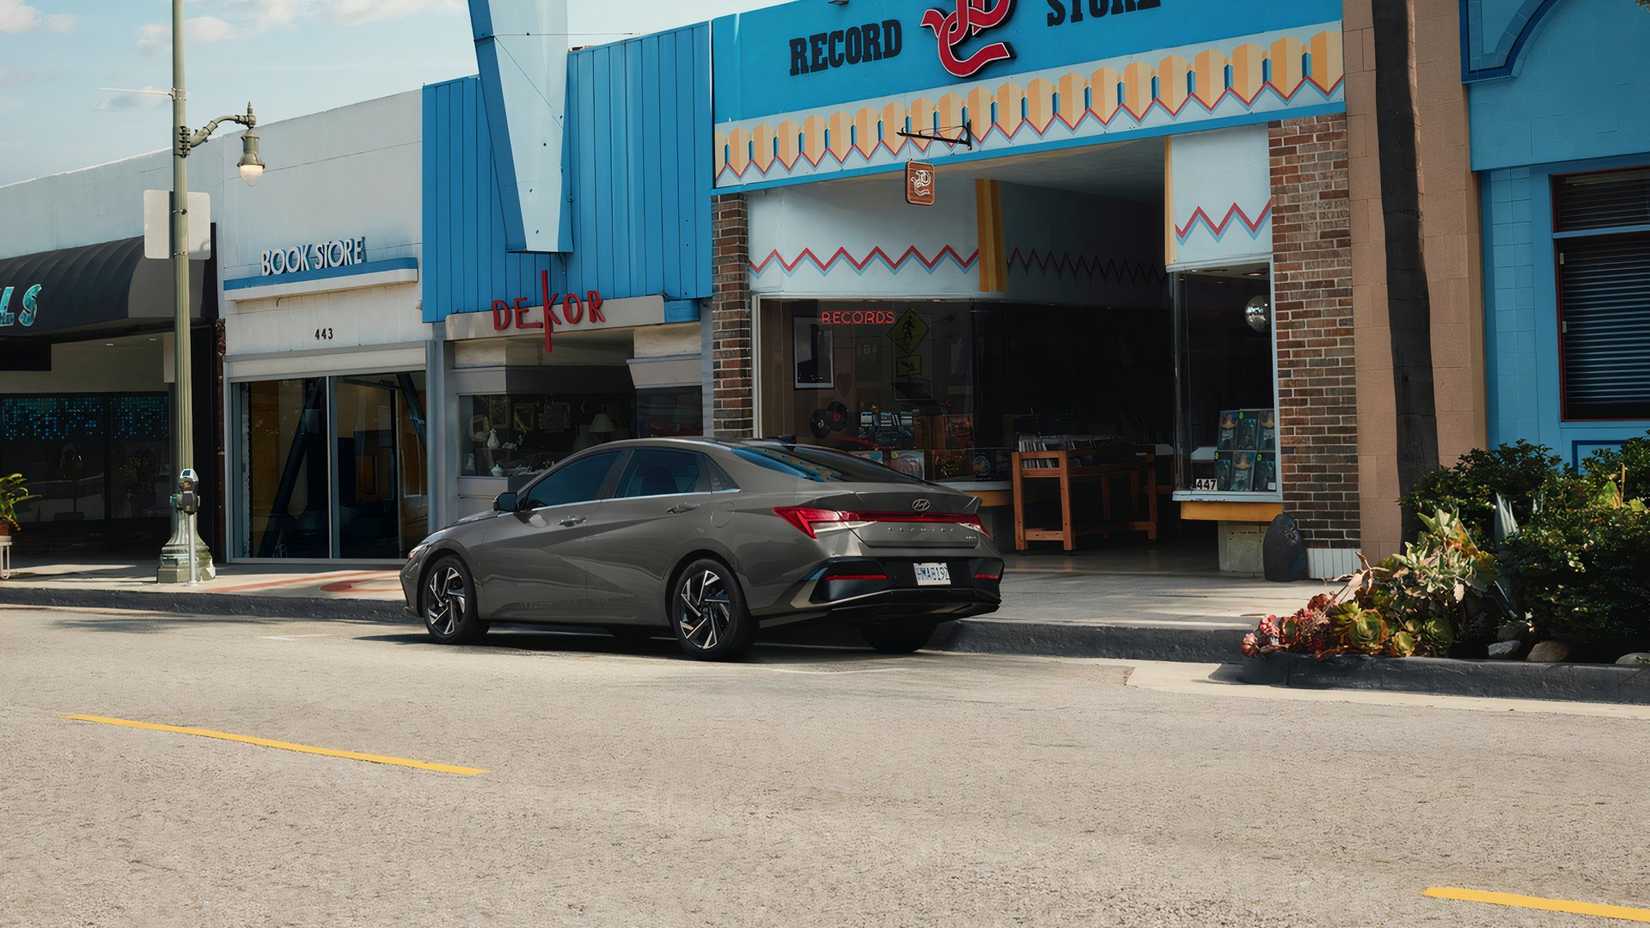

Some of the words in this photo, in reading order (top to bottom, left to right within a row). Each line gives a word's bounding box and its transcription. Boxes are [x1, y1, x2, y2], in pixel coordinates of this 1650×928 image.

[789, 19, 902, 77] RECORD
[261, 243, 310, 276] BOOK
[315, 238, 365, 270] STORE
[491, 270, 607, 353] DEKOR
[820, 310, 897, 325] RECORDS
[314, 327, 334, 341] 443
[1196, 479, 1217, 490] 447
